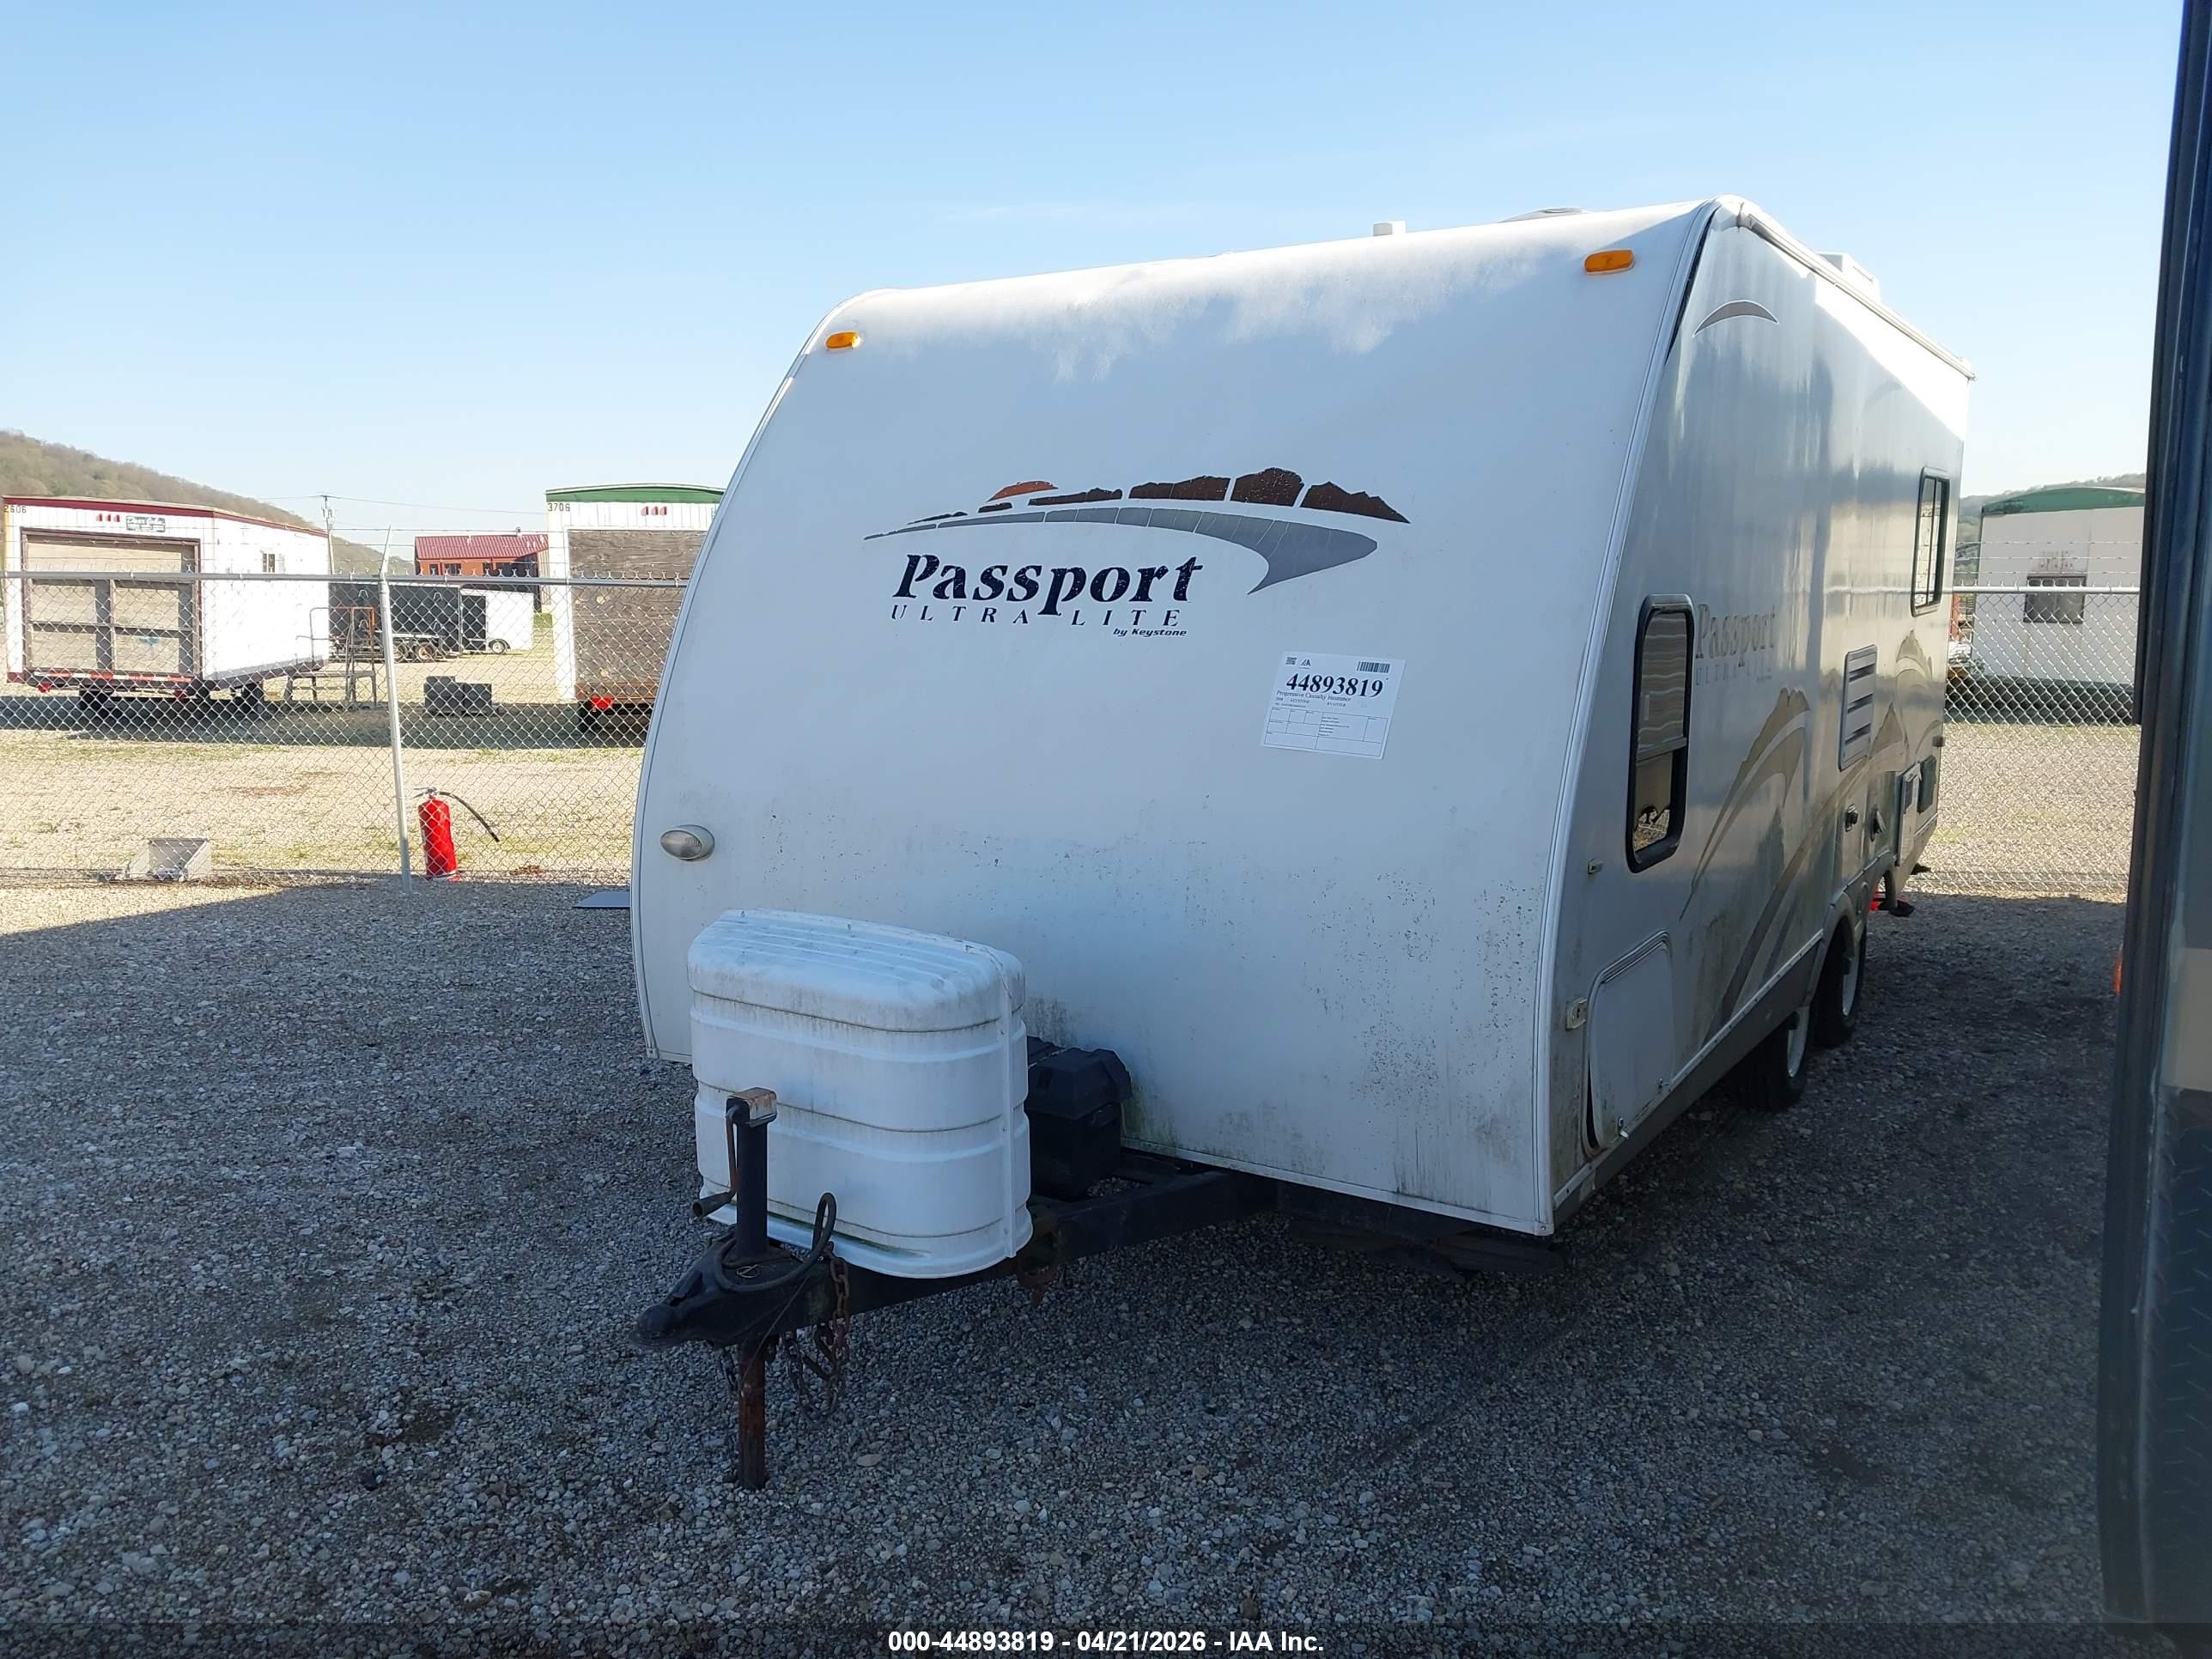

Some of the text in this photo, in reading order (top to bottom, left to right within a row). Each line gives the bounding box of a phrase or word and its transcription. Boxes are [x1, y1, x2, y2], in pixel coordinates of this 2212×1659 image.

[547, 502, 571, 512] 3706
[891, 554, 1204, 617] Passport
[890, 605, 1181, 627] ULTRA LITE
[1113, 628, 1188, 638] by Keystone
[1695, 604, 1776, 668] Passport
[1276, 690, 1304, 698] Progressive
[1286, 673, 1383, 697] 44893819
